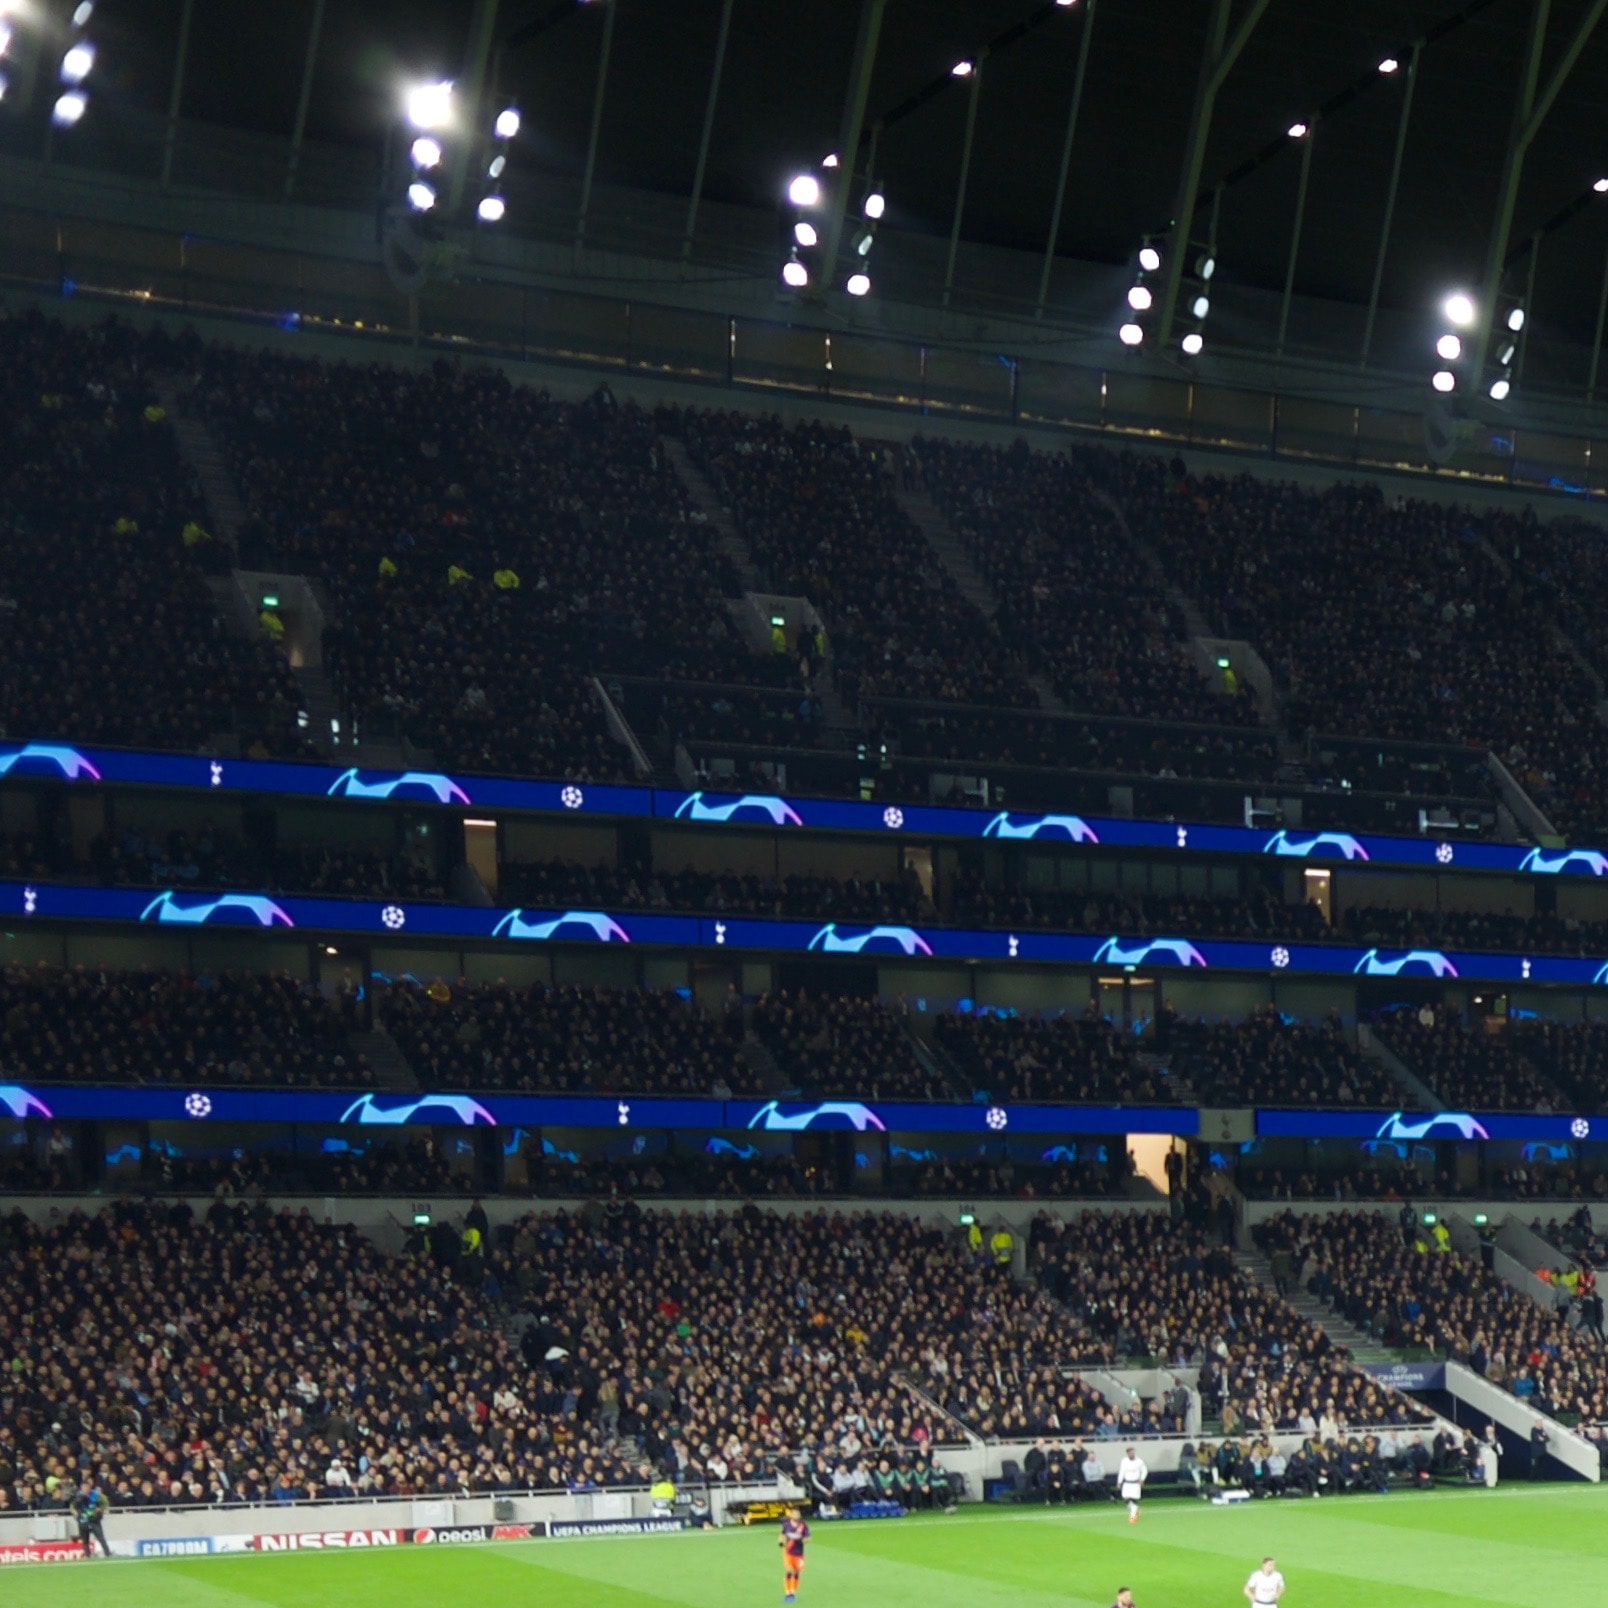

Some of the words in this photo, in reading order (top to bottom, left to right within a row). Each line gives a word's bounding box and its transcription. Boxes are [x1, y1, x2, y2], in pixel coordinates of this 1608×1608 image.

[438, 1526, 487, 1543] pepsi
[553, 1526, 581, 1538] UEFA
[582, 1522, 642, 1536] CHAMPIONS
[643, 1520, 682, 1533] LEAGUE
[261, 1528, 398, 1551] NISSAN
